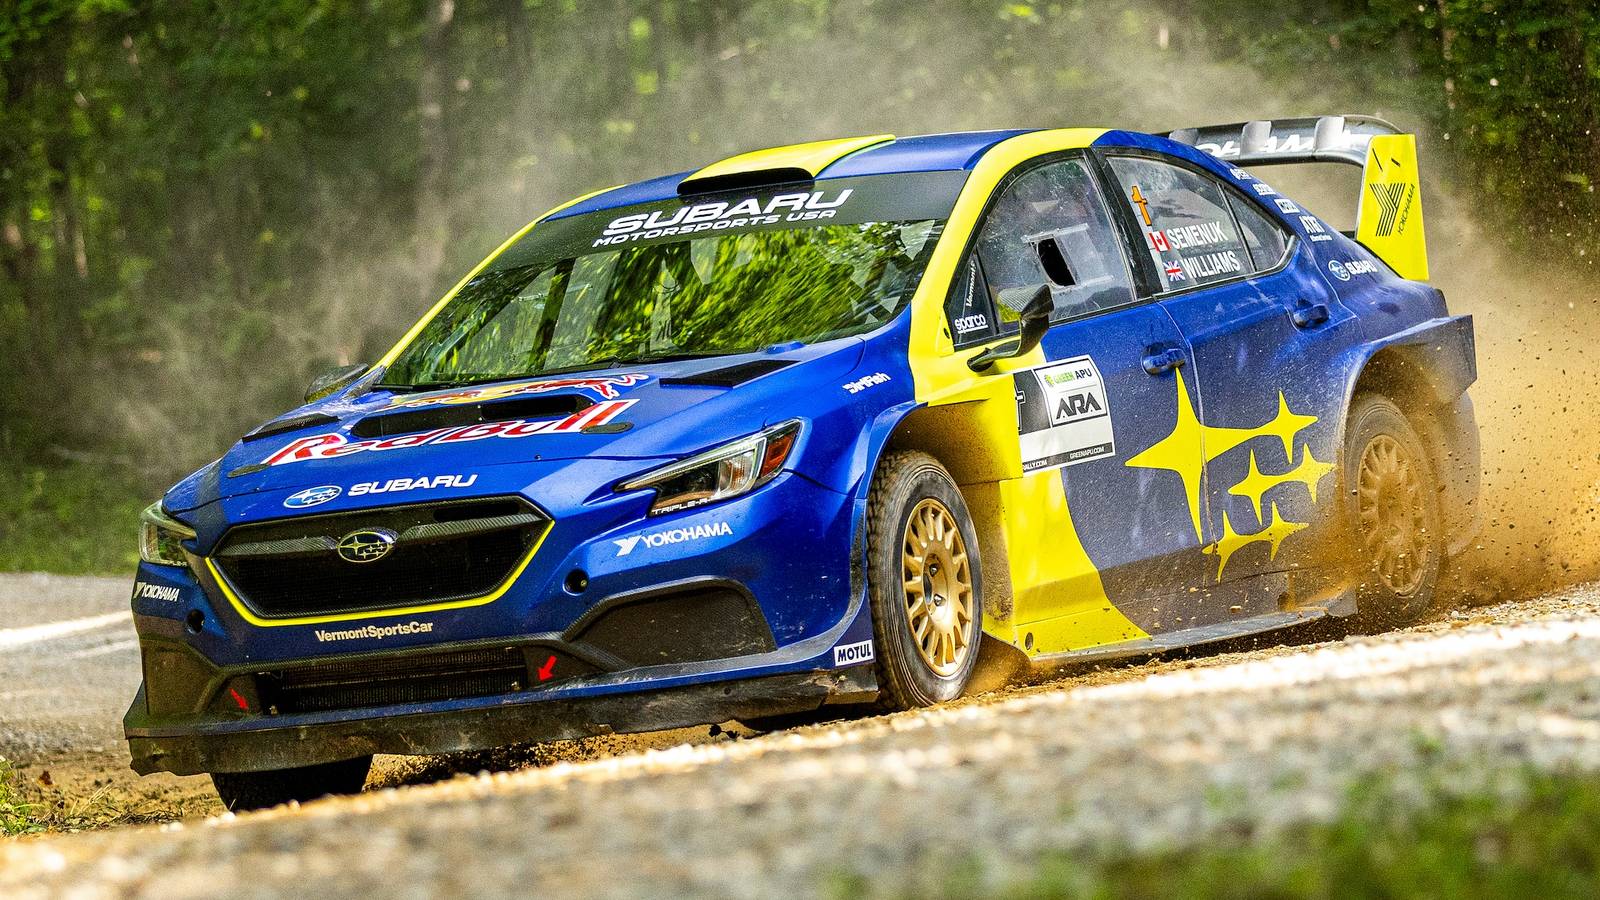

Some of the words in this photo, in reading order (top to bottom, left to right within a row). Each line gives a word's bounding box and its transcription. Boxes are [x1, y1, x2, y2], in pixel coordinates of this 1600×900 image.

[603, 189, 854, 236] SUBARU
[1397, 183, 1415, 236] YOKOHAMA
[592, 214, 782, 248] MOTORSPORTS
[786, 209, 836, 222] USA
[1167, 221, 1229, 249] SEMENUK
[1180, 251, 1241, 279] WILLIAMS
[1344, 260, 1378, 274] SUBARU
[955, 313, 988, 333] sparco
[1075, 368, 1092, 379] APU
[1056, 392, 1102, 419] ARA
[348, 474, 478, 496] SUBARU
[641, 521, 733, 549] YOKOHAMA
[142, 584, 180, 602] YOKOHAMA
[315, 621, 433, 641] VermontSportsCar
[838, 643, 871, 662] MOTUL
